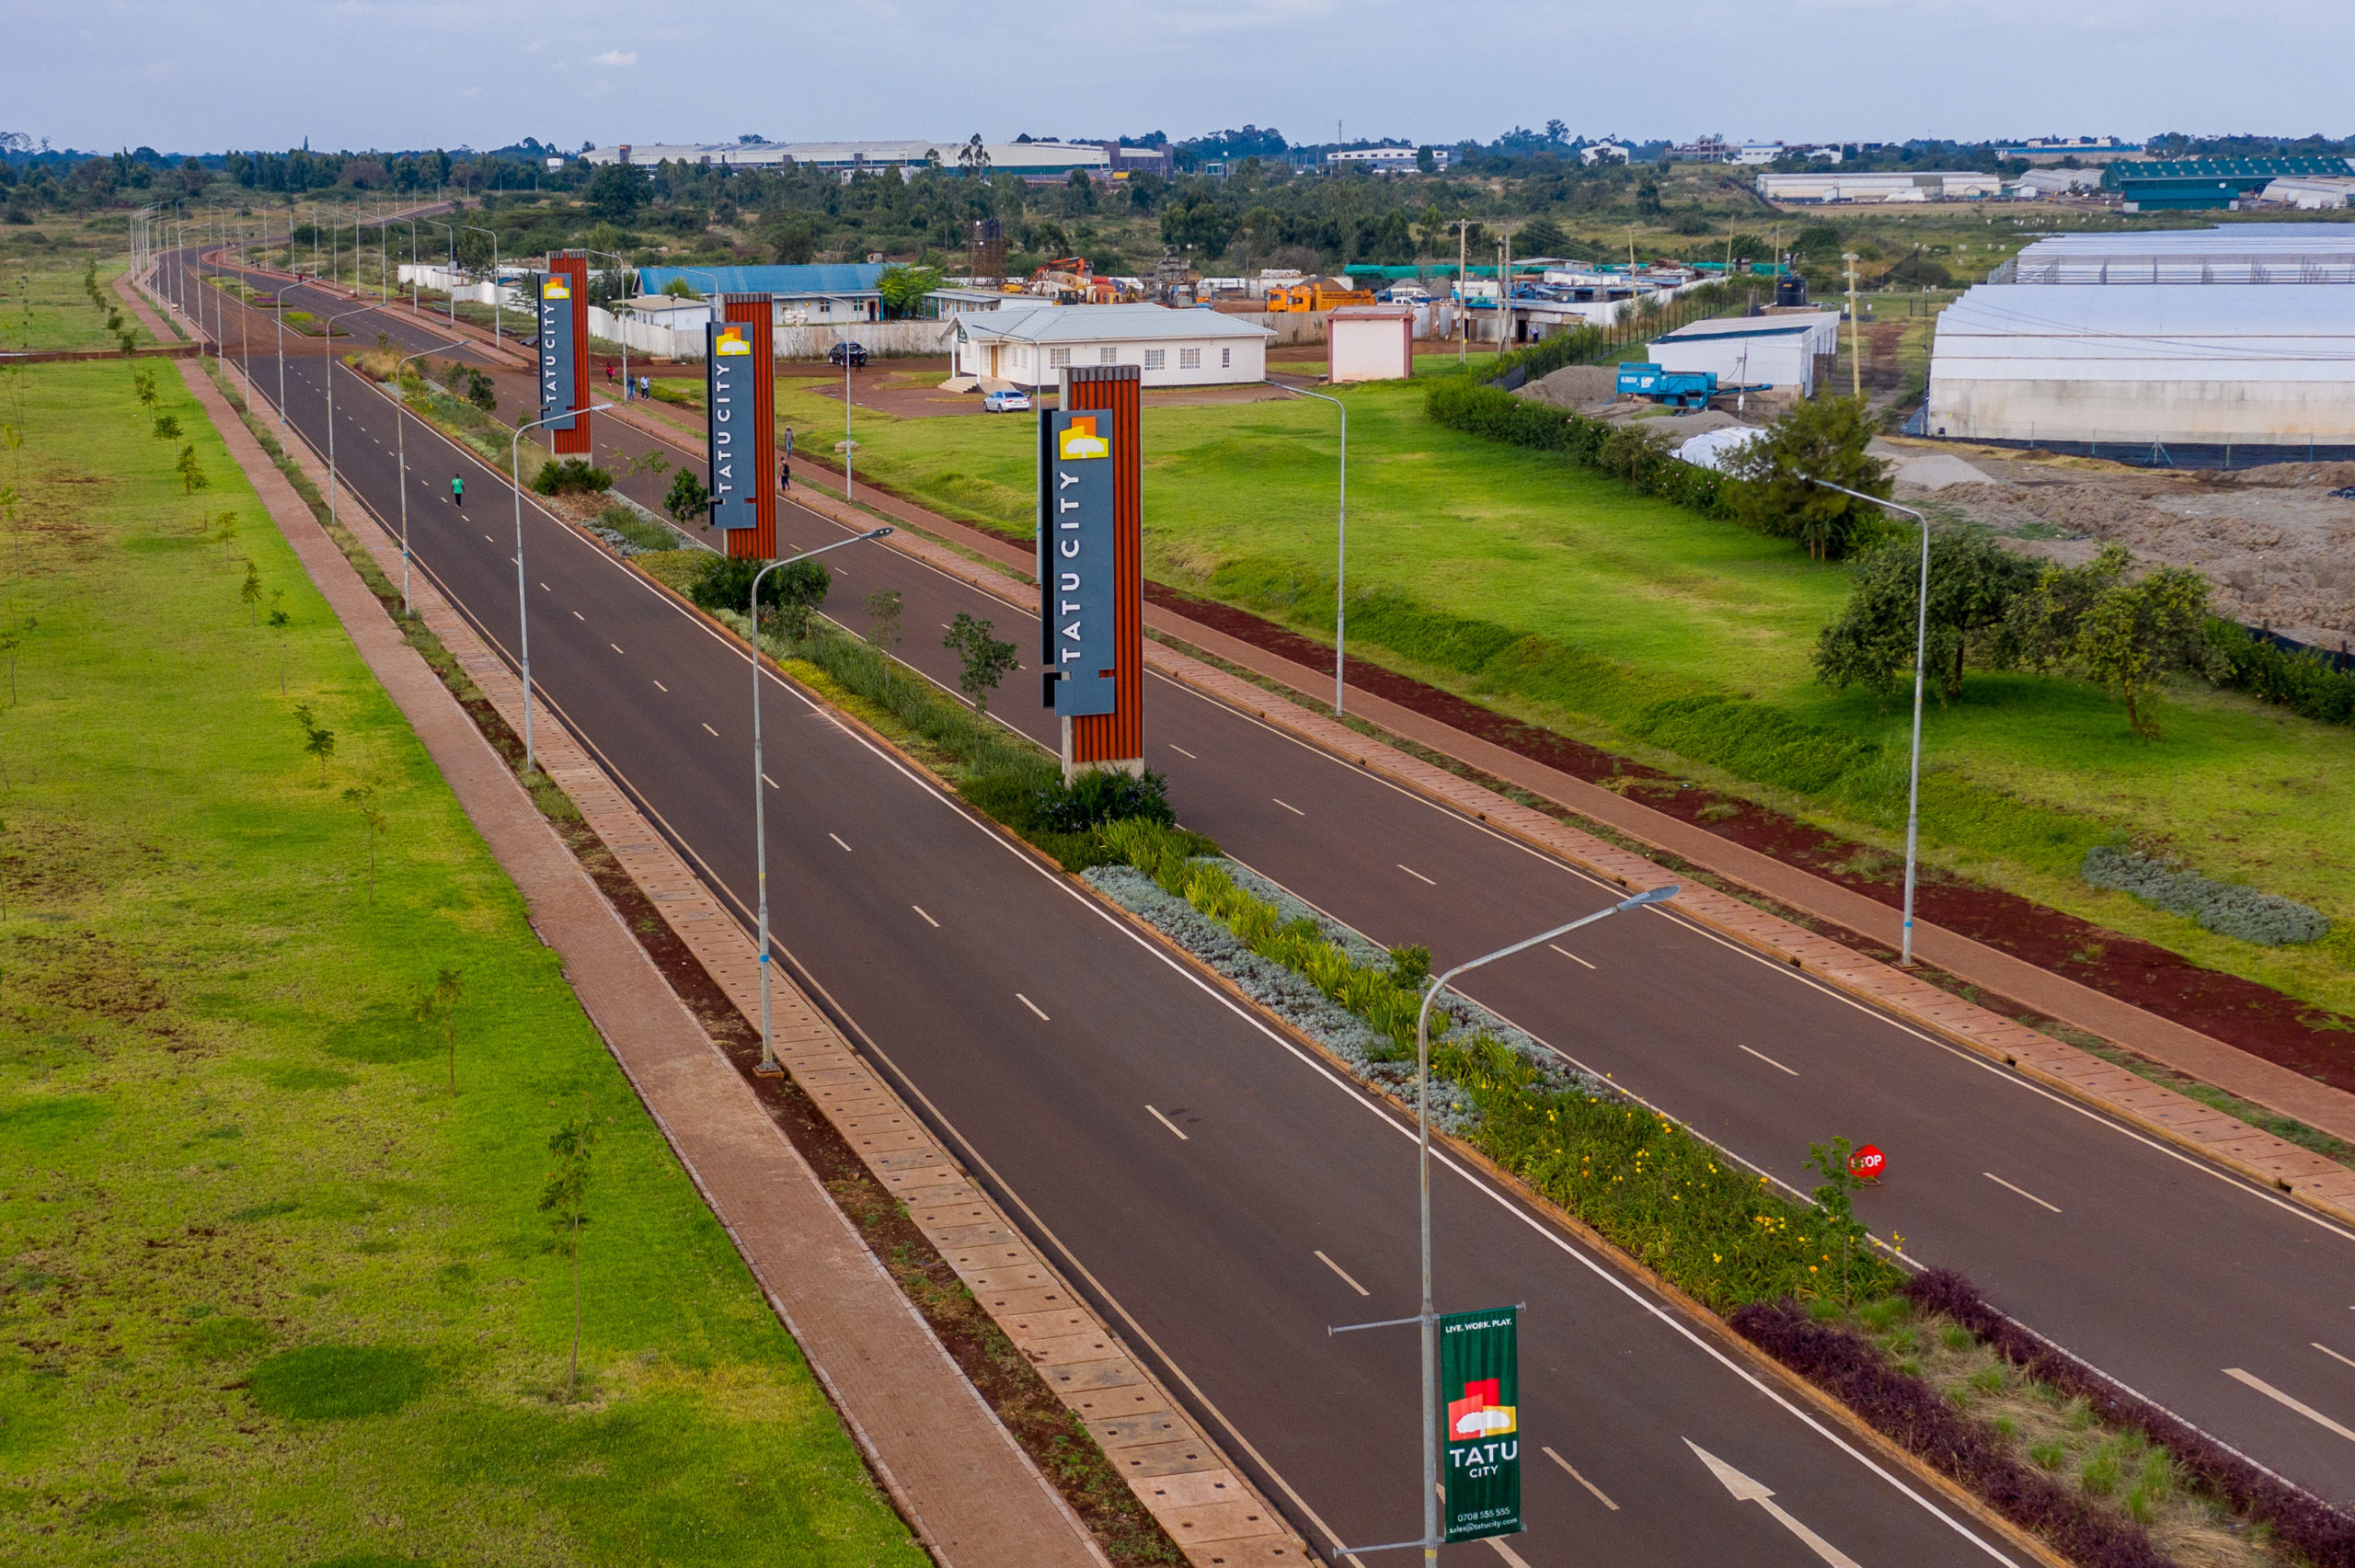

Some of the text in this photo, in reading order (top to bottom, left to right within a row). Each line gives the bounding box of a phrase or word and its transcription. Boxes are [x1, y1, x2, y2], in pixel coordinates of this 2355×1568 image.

[544, 303, 557, 403] TATU CITY
[717, 363, 732, 494] TATU CITY
[1060, 471, 1081, 663] TATU CITY
[1445, 1318, 1513, 1333] LIVE. WORK. PLAY.
[1449, 1440, 1518, 1468] TATU
[1469, 1465, 1499, 1479] CITY
[1457, 1506, 1511, 1522] 0708 555 555
[1449, 1517, 1518, 1534] sales@tatucity.com
